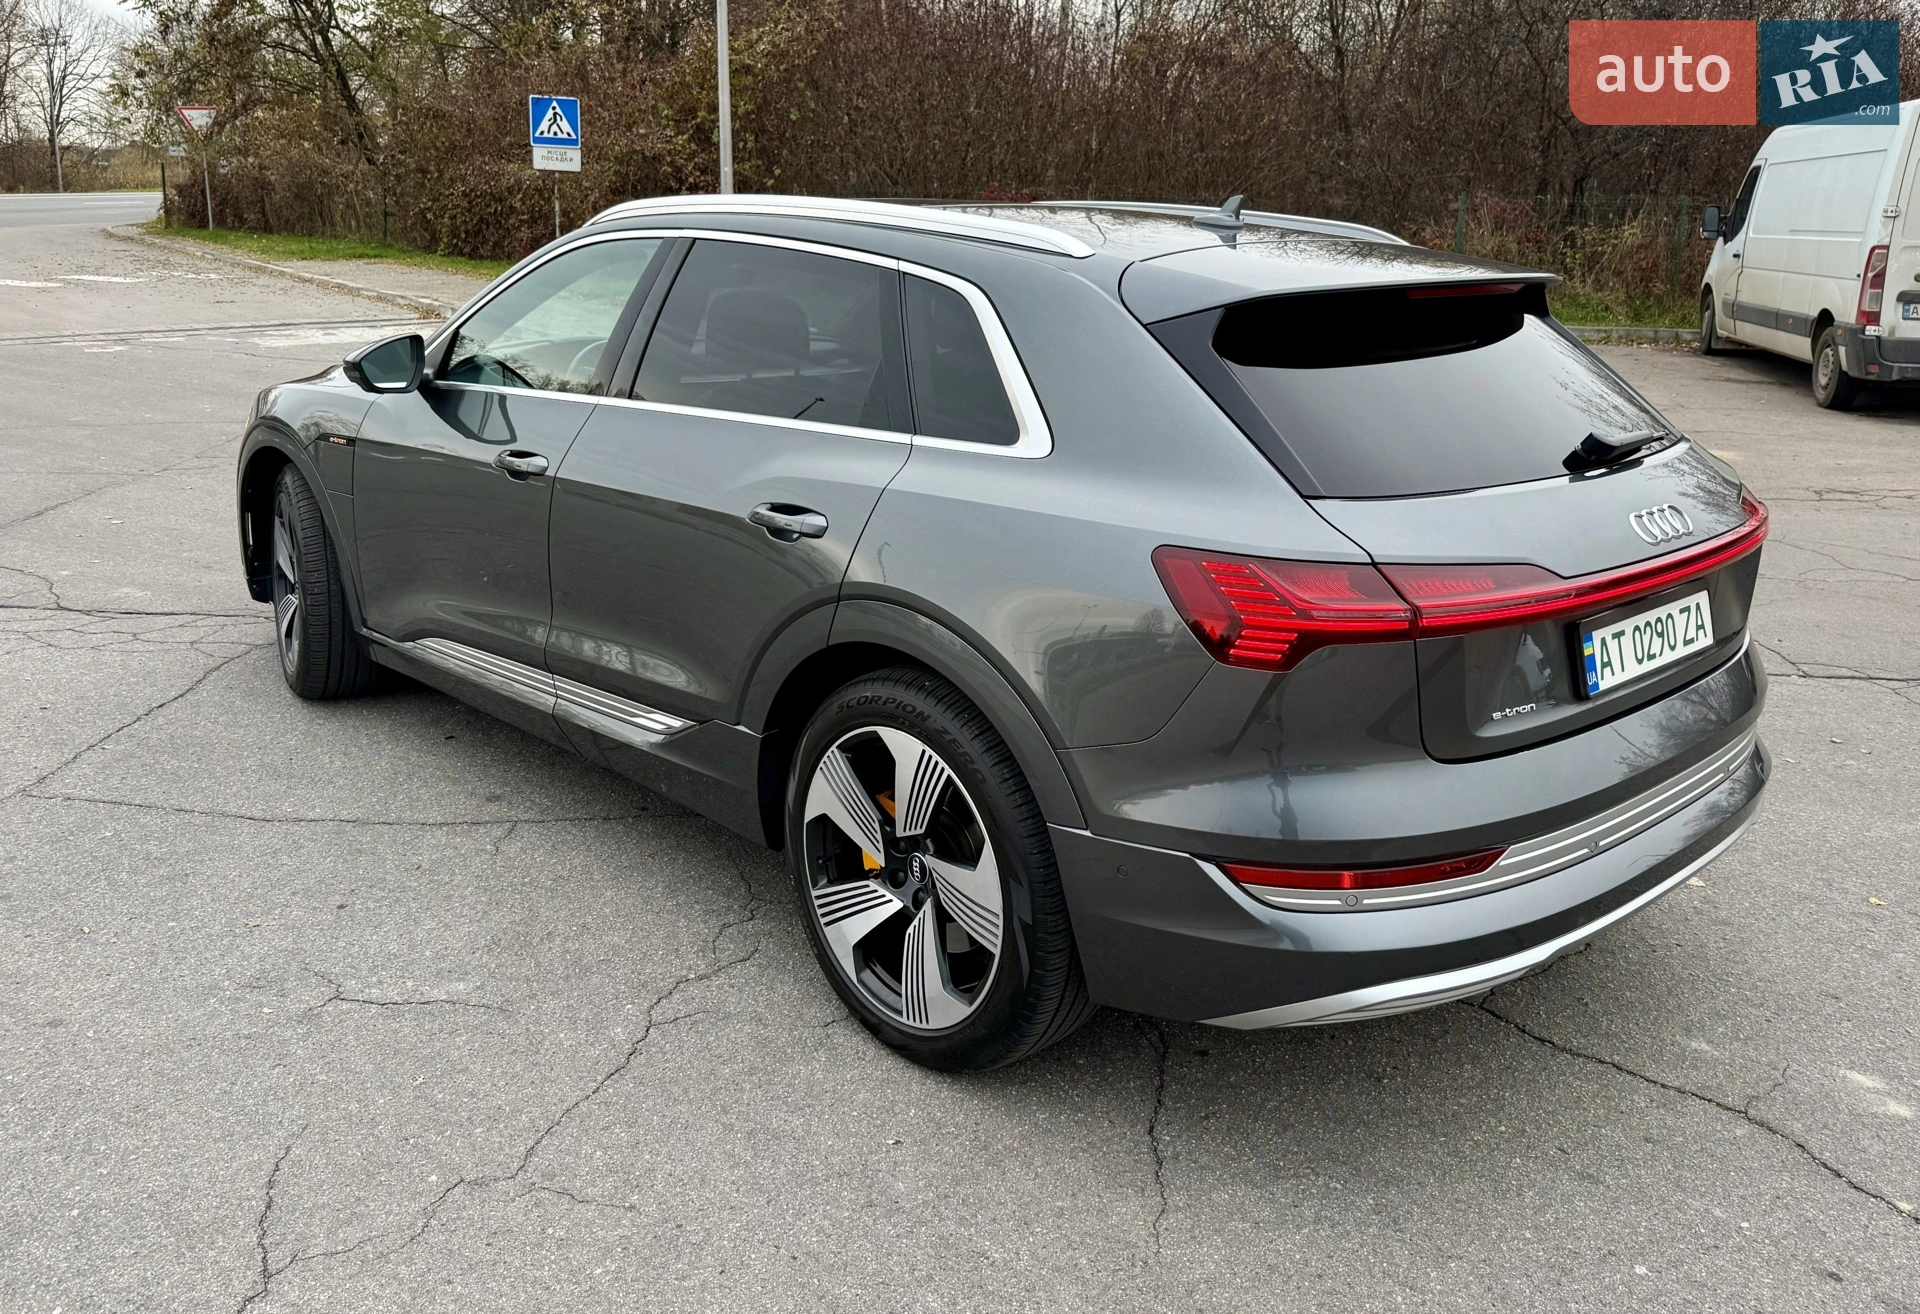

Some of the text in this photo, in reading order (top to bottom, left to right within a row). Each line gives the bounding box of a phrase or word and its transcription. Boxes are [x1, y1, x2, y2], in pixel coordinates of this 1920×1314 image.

[1600, 602, 1707, 681] AT 0290 ZA
[1586, 671, 1597, 685] UA
[835, 694, 932, 723] SCORPION
[1492, 703, 1536, 720] e-tron
